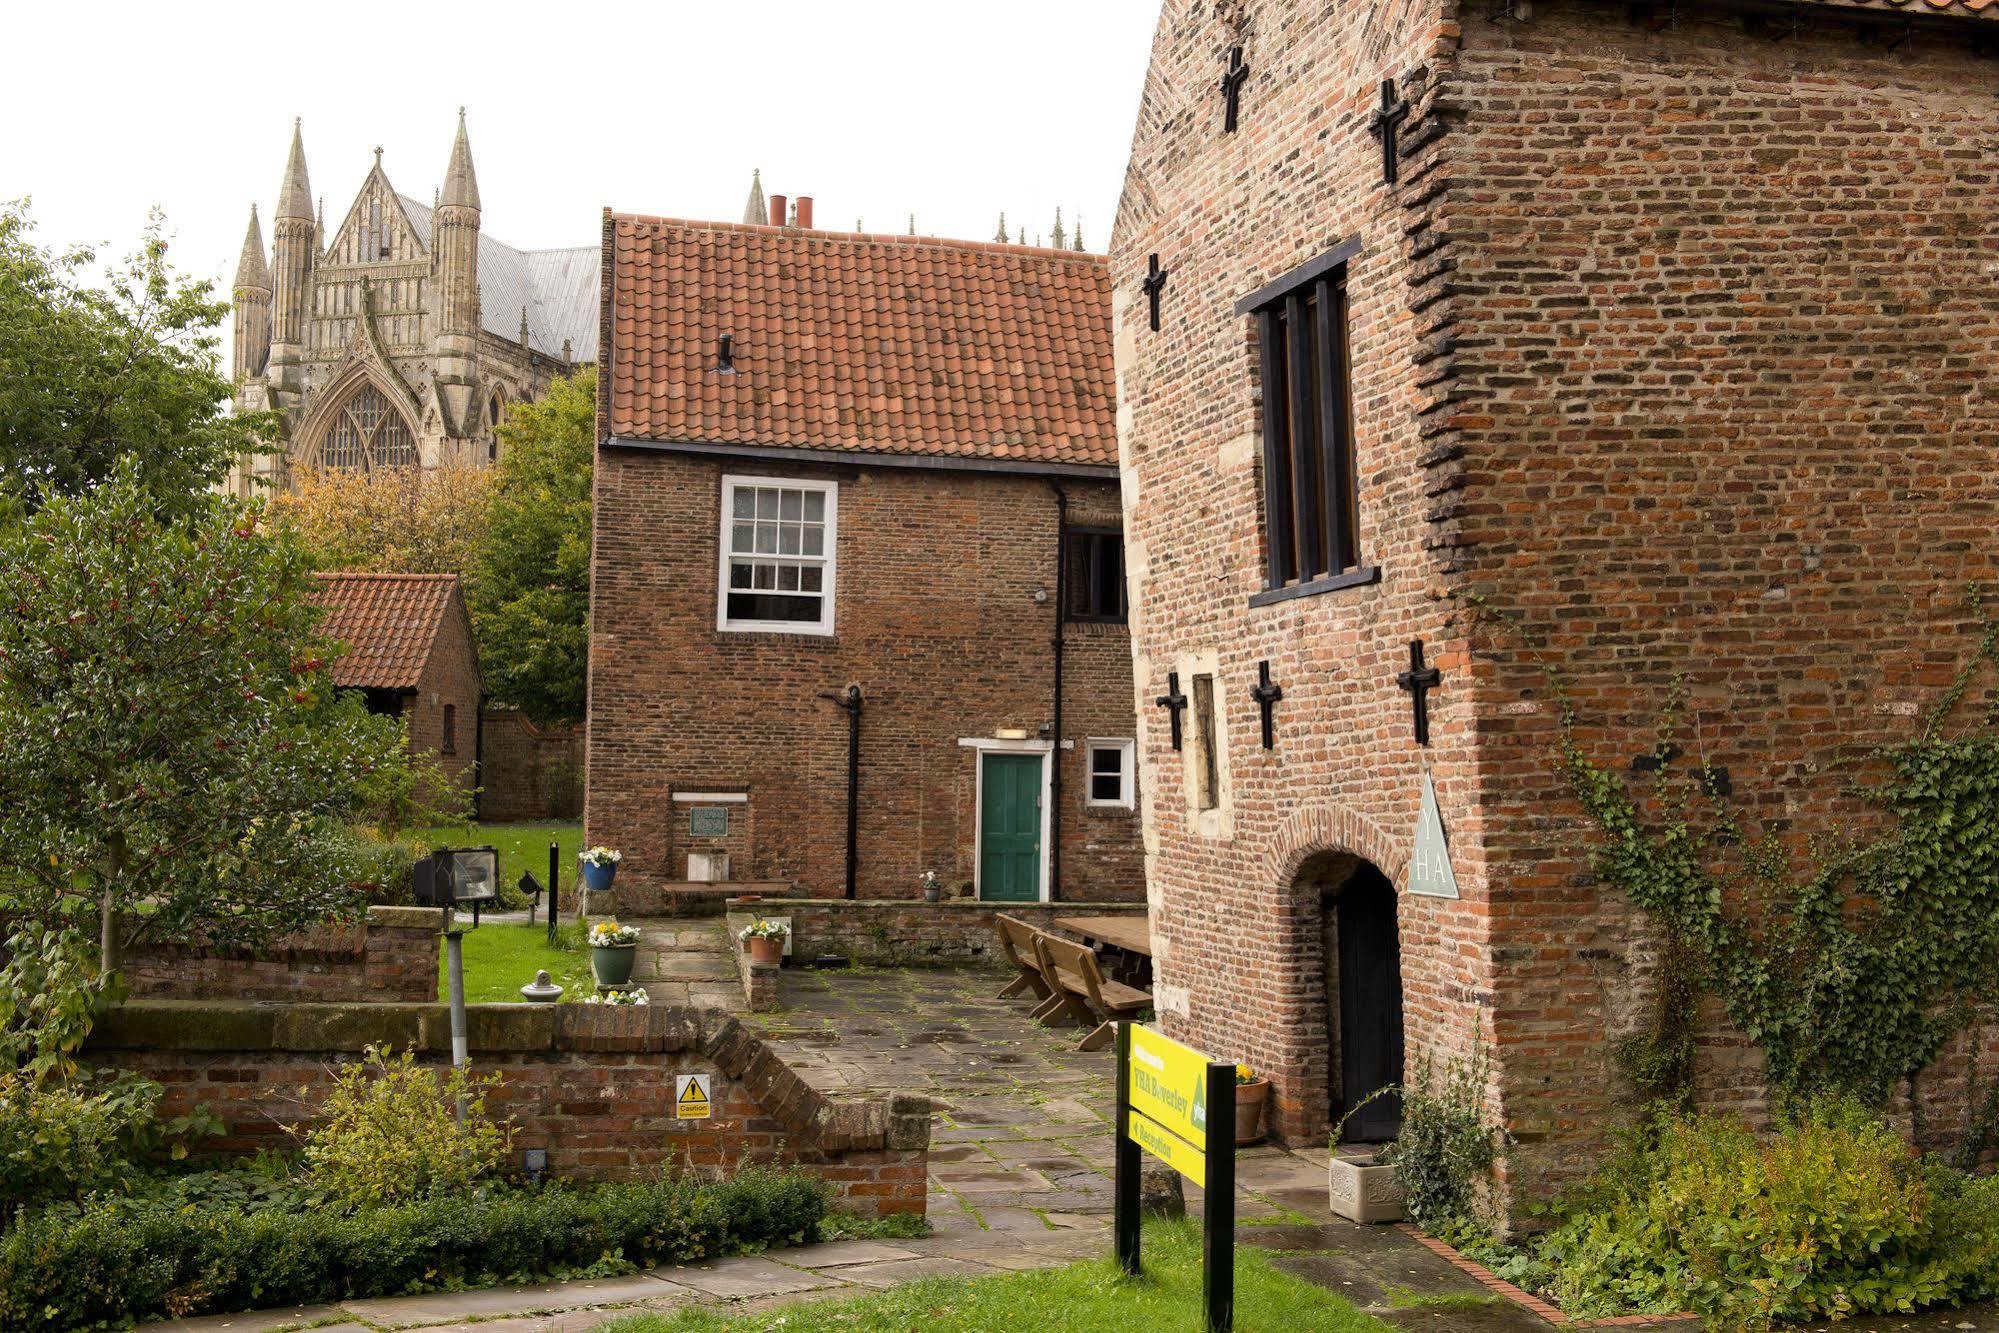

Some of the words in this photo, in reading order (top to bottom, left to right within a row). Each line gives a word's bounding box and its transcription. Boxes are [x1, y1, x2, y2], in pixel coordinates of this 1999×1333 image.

[1422, 807, 1434, 840] Y
[1416, 848, 1446, 883] HA
[1134, 1066, 1151, 1094] YHA
[1152, 1076, 1188, 1118] Beverley
[1139, 1124, 1171, 1159] Reception
